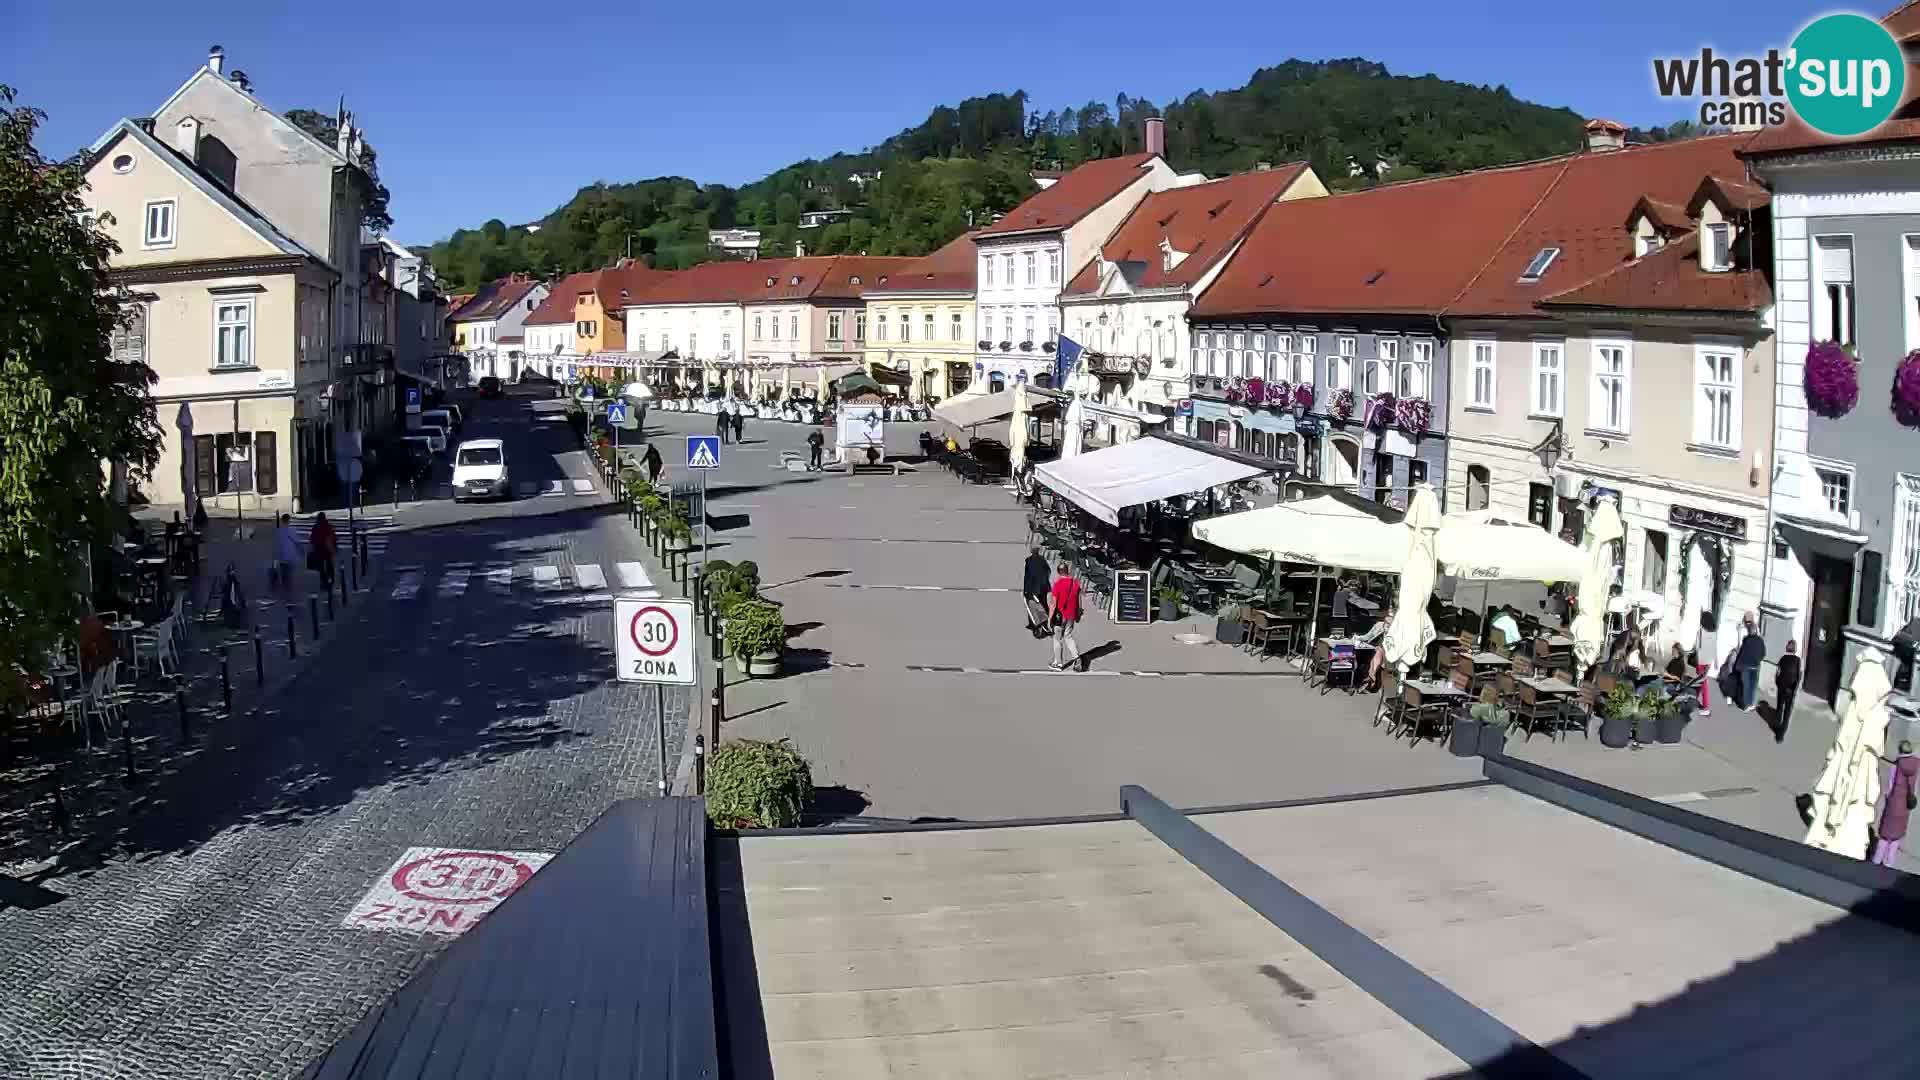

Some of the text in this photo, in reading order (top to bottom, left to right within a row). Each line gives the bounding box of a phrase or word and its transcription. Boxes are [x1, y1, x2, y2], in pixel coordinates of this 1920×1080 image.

[643, 621, 667, 643] 30
[633, 659, 678, 677] ZONA
[420, 863, 505, 891] 30
[363, 902, 480, 929] ZON
